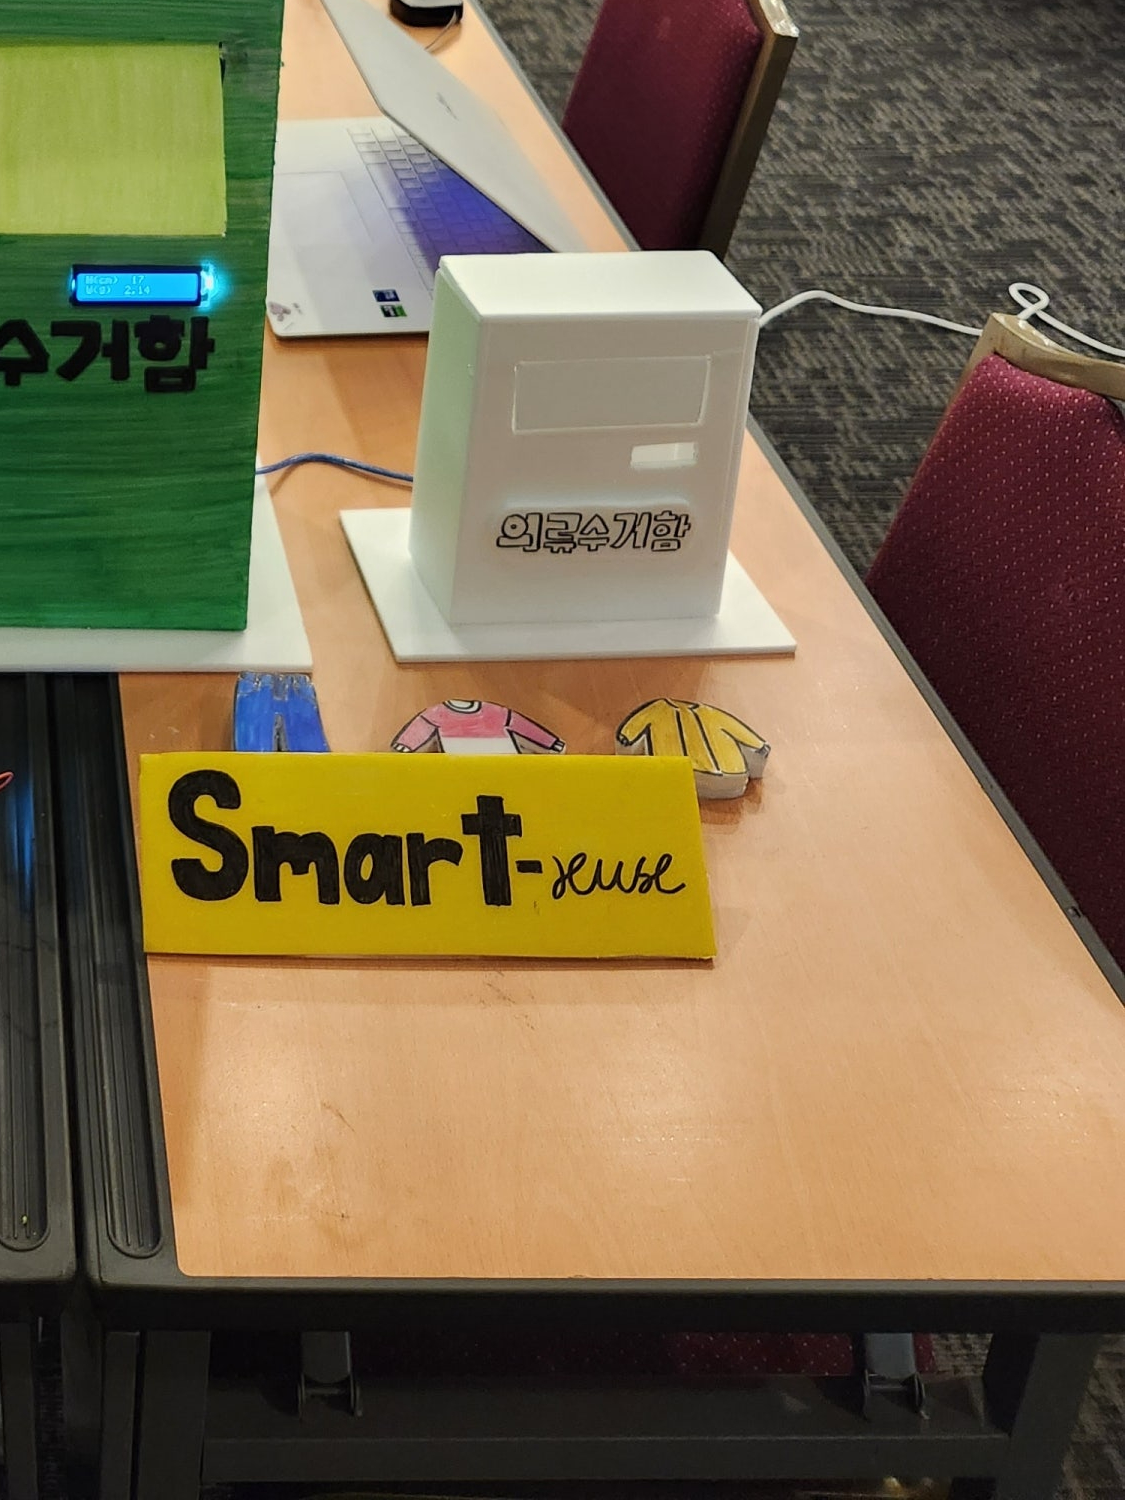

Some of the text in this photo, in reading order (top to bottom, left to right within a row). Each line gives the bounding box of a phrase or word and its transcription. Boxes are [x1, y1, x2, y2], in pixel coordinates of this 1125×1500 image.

[131, 275, 146, 285] 17
[123, 285, 151, 296] 2.14
[495, 510, 691, 553] 의류수거함
